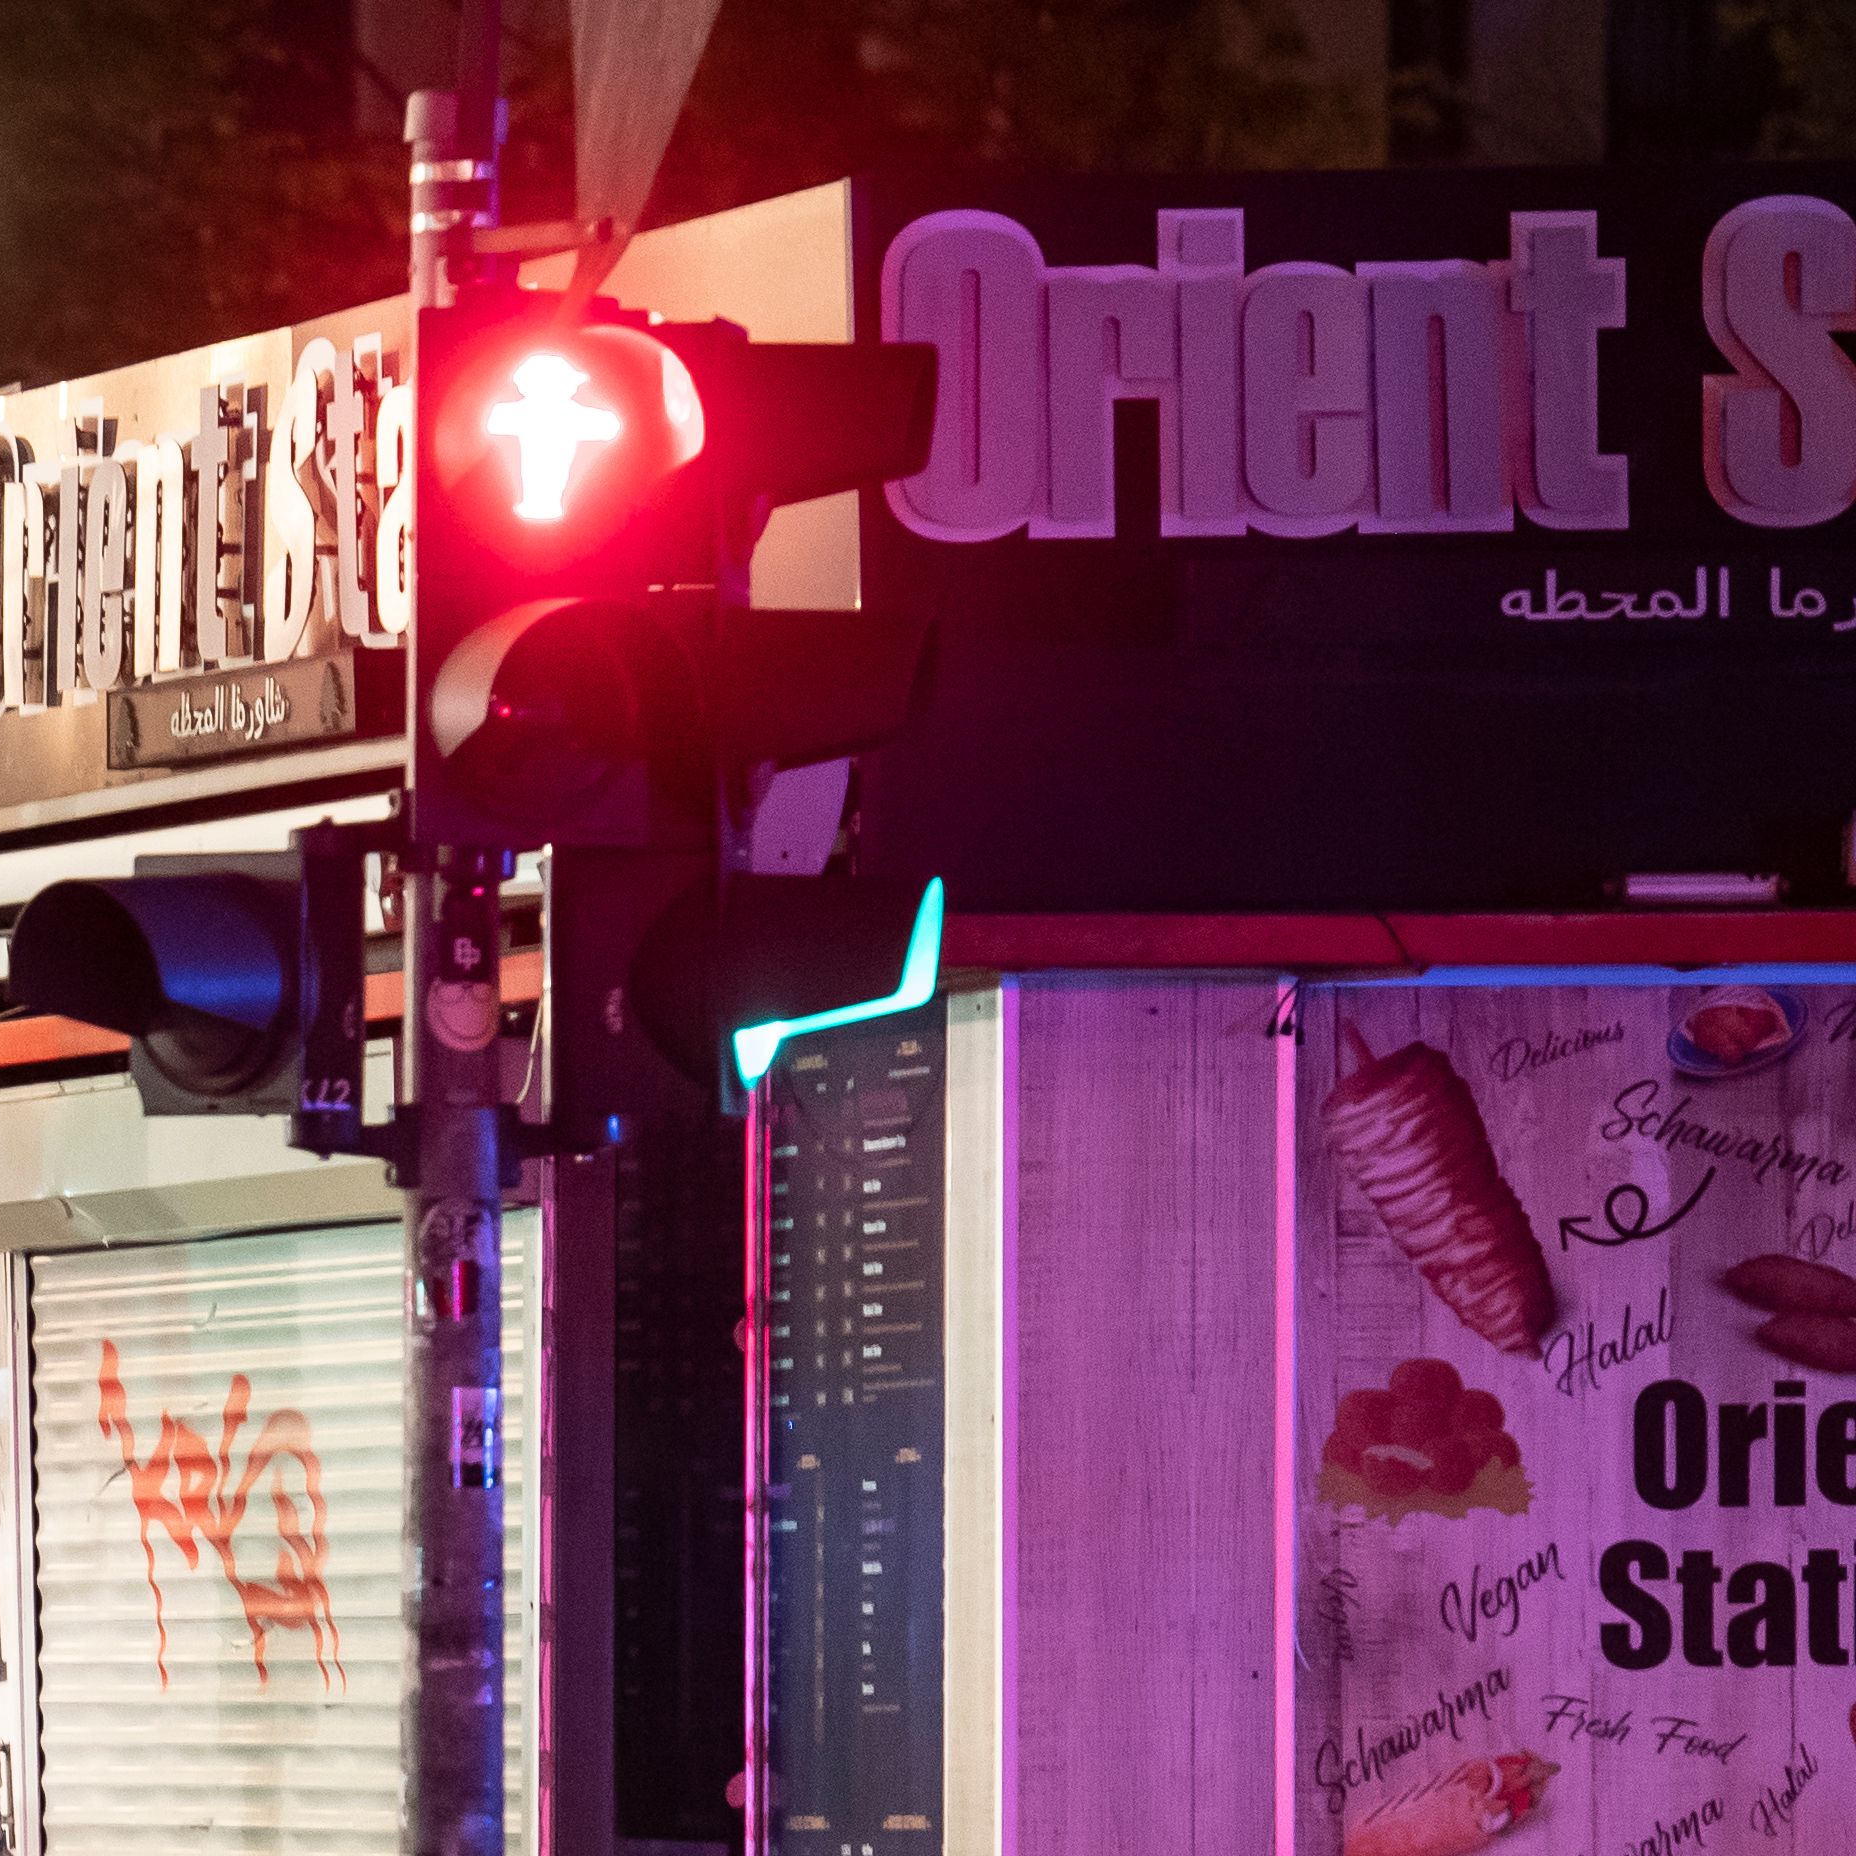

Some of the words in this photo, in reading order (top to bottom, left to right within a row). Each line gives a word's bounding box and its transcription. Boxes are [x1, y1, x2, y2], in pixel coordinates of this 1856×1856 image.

[882, 206, 1629, 543] Orient
[1490, 1020, 1626, 1084] Delicious
[1601, 1079, 1849, 1194] Schawarma
[1543, 1285, 1675, 1397] Halal
[1441, 1542, 1565, 1642] Vegan
[1599, 1538, 1856, 1670] Stat
[1315, 1666, 1511, 1815] Schawarma
[1541, 1694, 1633, 1745] Fresh
[1650, 1716, 1748, 1765] Food
[1749, 1742, 1818, 1838] Halal
